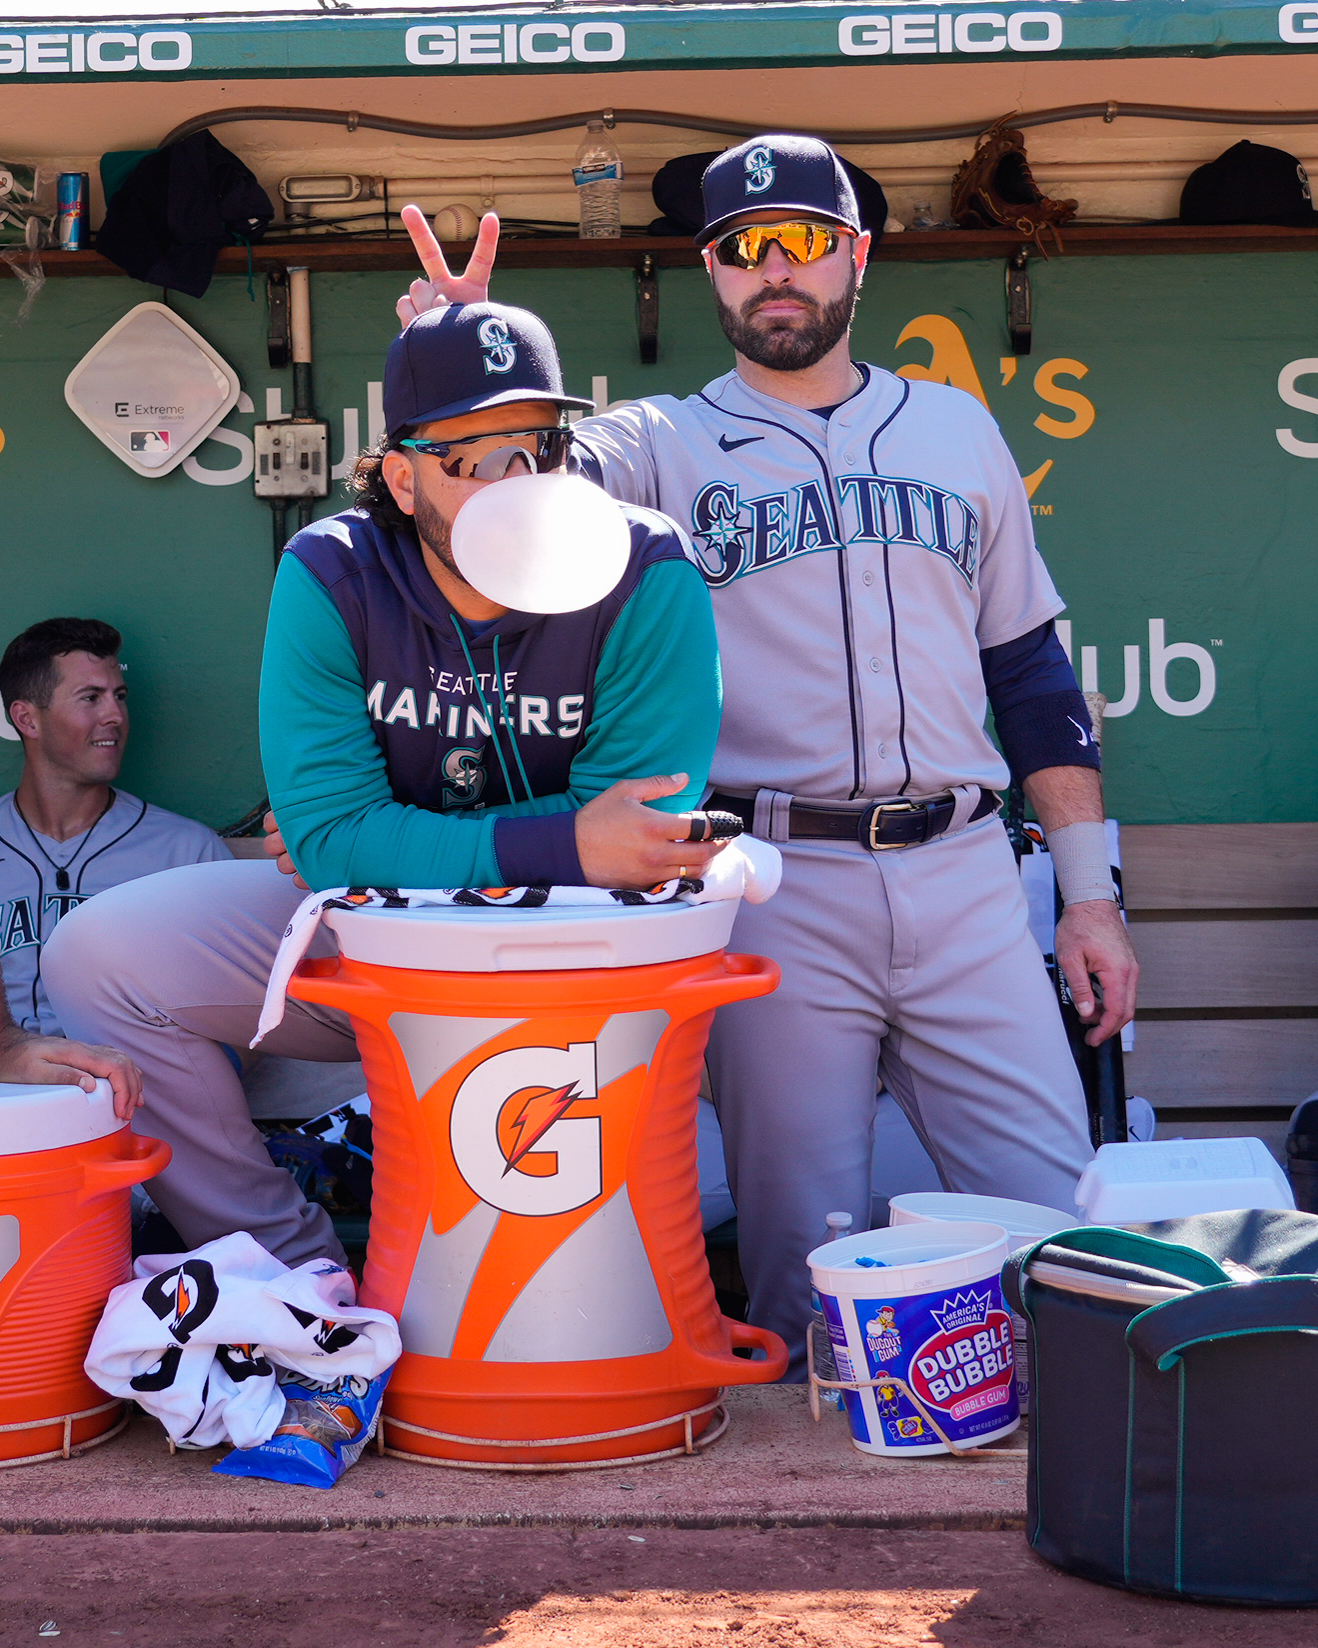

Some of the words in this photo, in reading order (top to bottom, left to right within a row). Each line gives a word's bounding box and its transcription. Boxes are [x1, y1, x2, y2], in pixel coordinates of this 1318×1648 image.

[405, 22, 626, 65] GEICO
[838, 12, 1063, 56] GEICO
[135, 404, 184, 415] Extreme
[1031, 505, 1053, 515] TM
[692, 474, 980, 590] SEATTLE
[428, 666, 518, 695] EATTLE
[449, 1041, 603, 1217] G
[942, 1302, 985, 1324] AMERICA'S
[946, 1315, 982, 1329] ORIGINAL
[866, 1336, 901, 1352] DUGOUT
[878, 1347, 900, 1362] GUM
[917, 1321, 1009, 1380] DUBBLE
[927, 1343, 1013, 1402] BUBBLE
[954, 1397, 986, 1416] BUBBLE
[987, 1389, 1007, 1404] GUM
